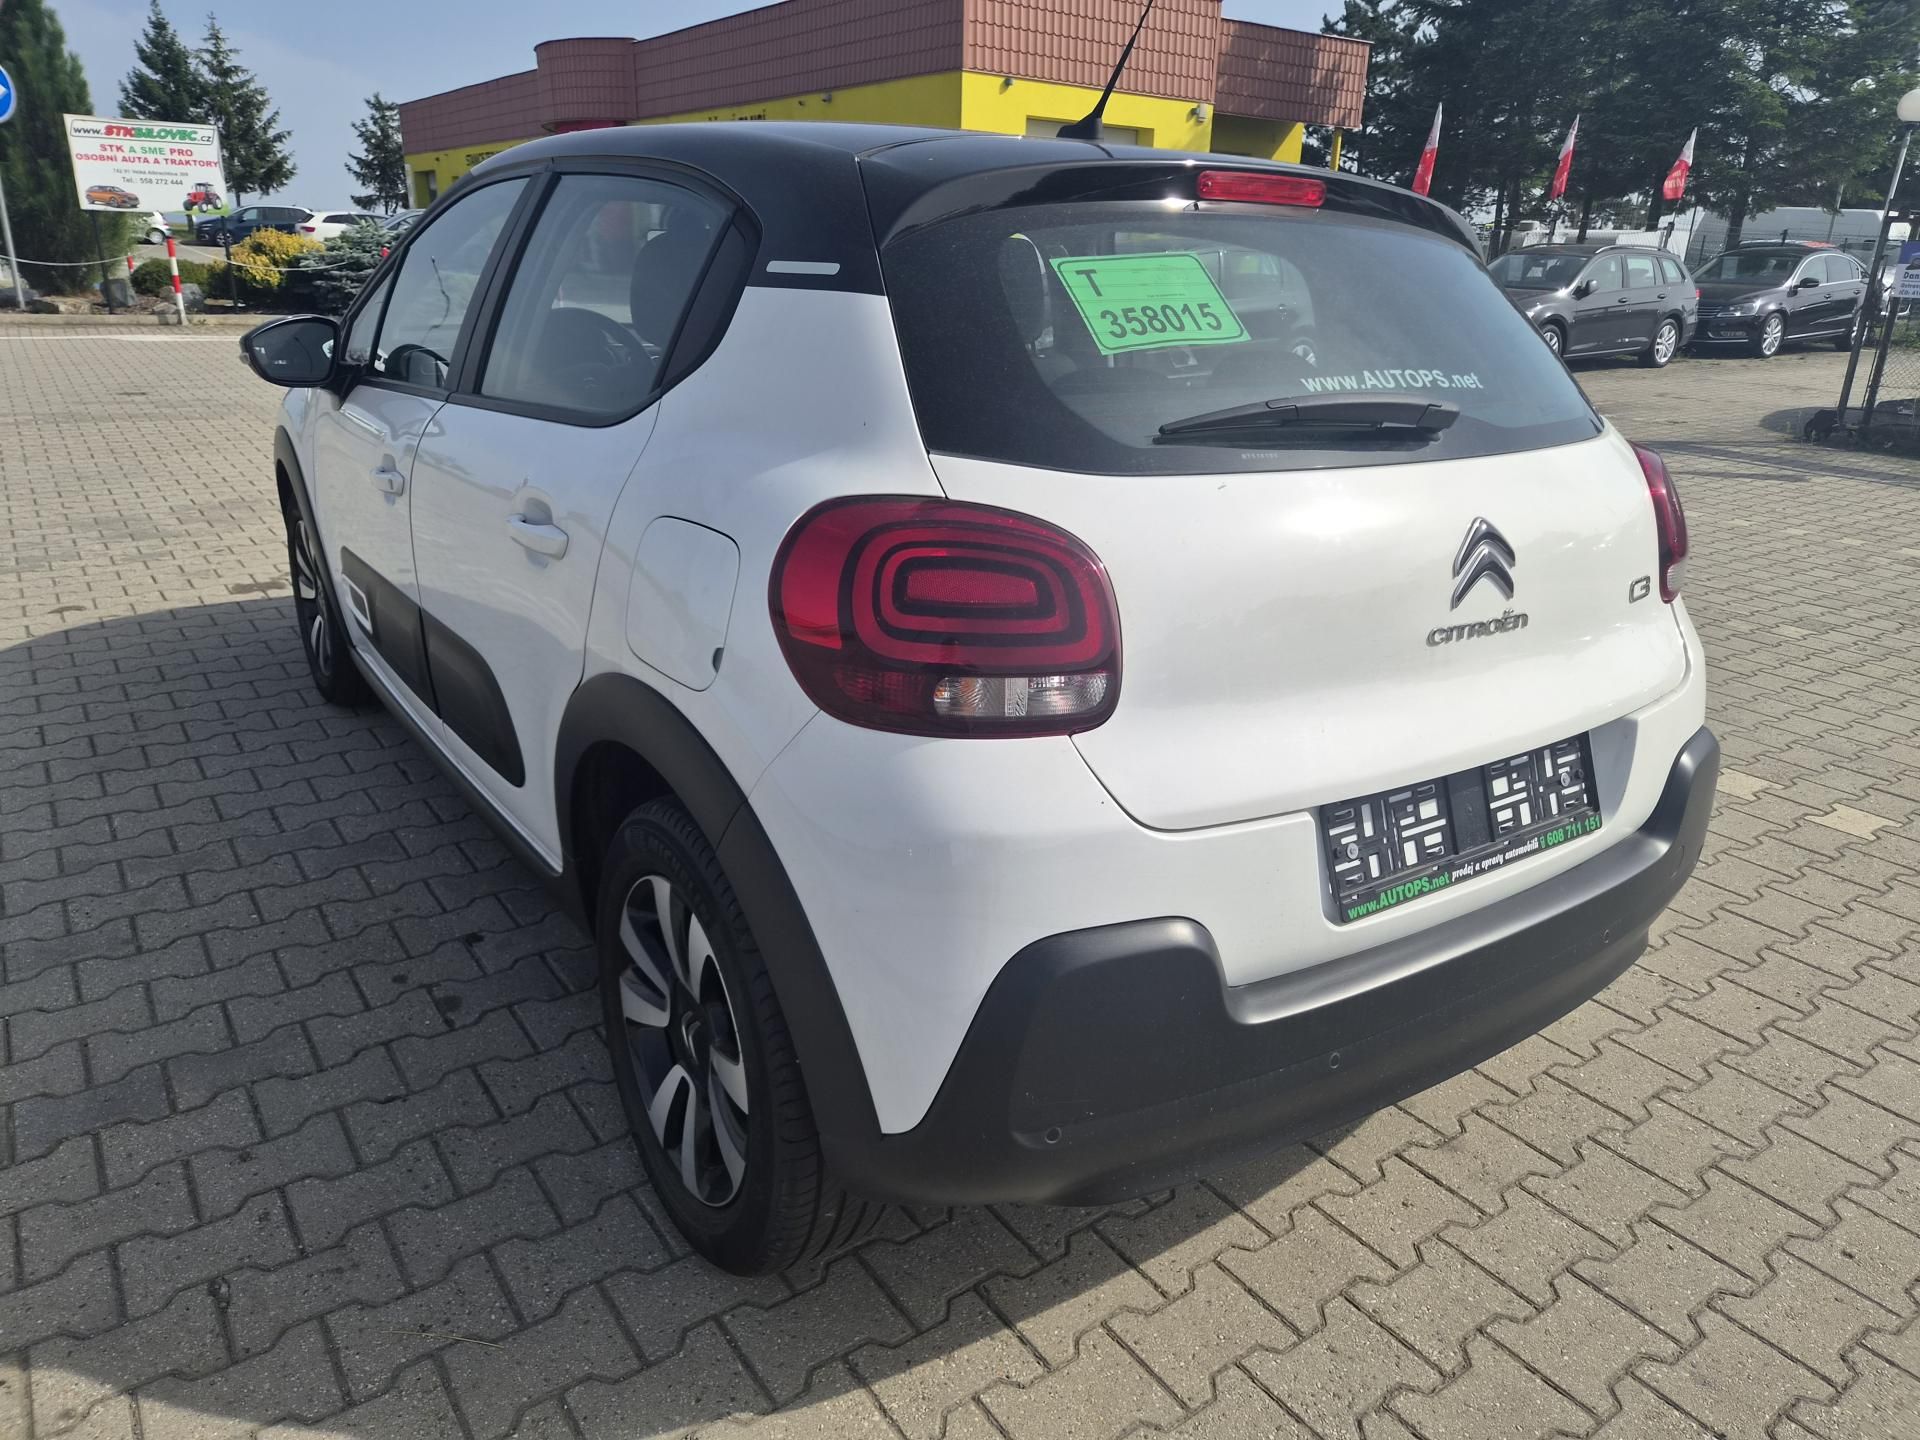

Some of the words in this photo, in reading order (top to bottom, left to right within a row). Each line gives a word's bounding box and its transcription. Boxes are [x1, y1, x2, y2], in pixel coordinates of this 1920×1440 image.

[75, 152, 118, 162] OSOBNÍ
[121, 156, 149, 165] AUTA
[164, 158, 219, 168] TRAKTORY
[99, 143, 124, 153] STK
[128, 146, 137, 155] A
[140, 146, 166, 155] SME
[169, 148, 193, 157] PRO
[1075, 269, 1102, 297] T
[1100, 303, 1222, 339] 358015
[1426, 608, 1529, 647] CITROËN
[1347, 872, 1450, 920] www.AUTOPS.net
[1451, 862, 1474, 882] prodej
[1475, 864, 1480, 872] a
[1481, 853, 1504, 870] opravy
[1546, 829, 1565, 844] 608
[1565, 823, 1582, 839] 711
[1585, 815, 1601, 832] 151
